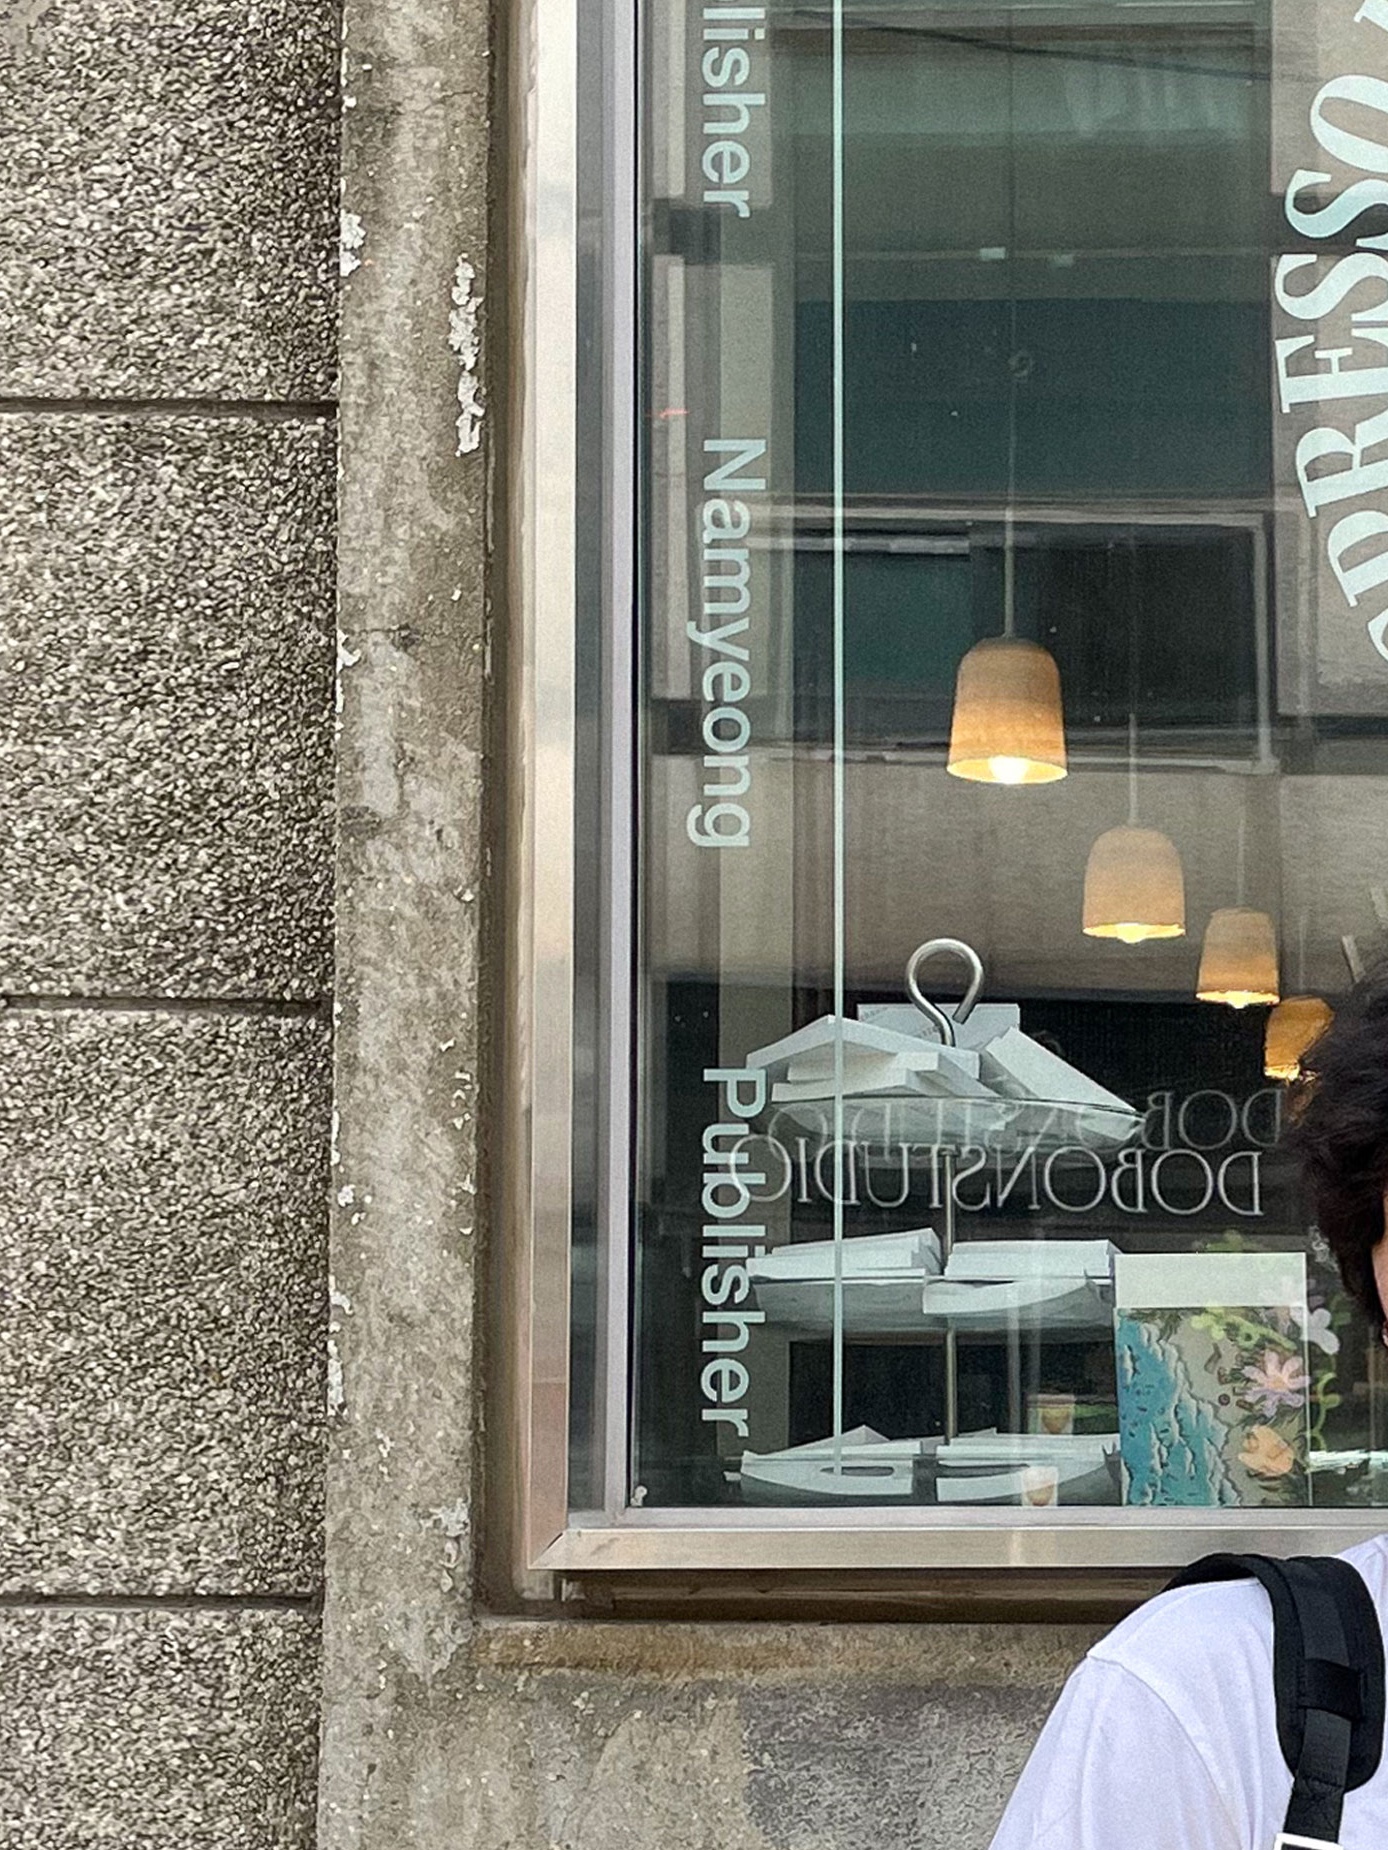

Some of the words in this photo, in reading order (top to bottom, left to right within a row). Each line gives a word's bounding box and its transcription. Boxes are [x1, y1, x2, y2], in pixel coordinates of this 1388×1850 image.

[701, 0, 767, 219] lisher
[686, 437, 768, 849] Namyeong
[700, 1067, 768, 1437] Publisher
